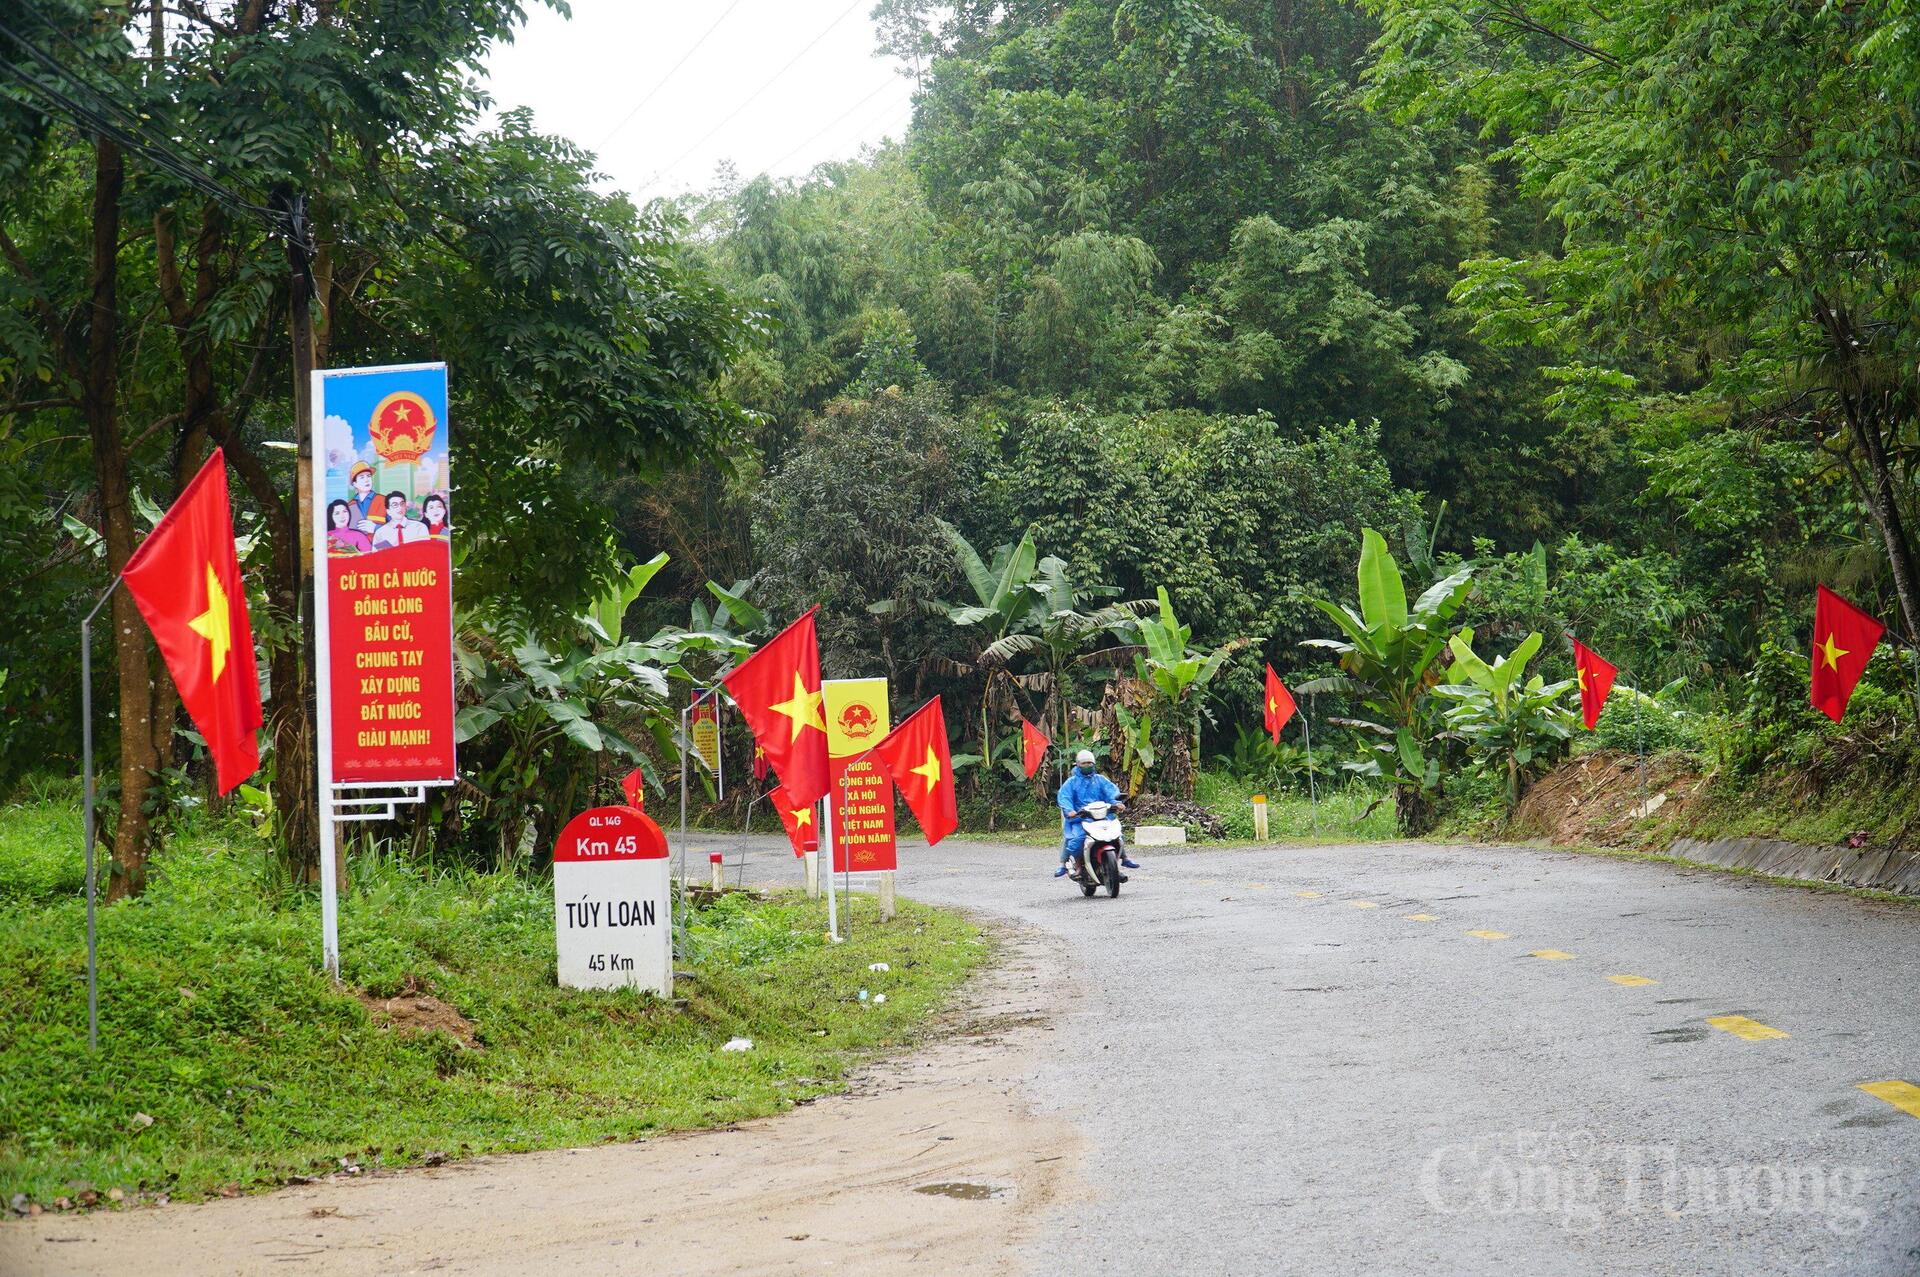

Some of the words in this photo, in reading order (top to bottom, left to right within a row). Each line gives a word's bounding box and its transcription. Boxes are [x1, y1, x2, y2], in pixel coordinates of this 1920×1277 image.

[340, 570, 358, 591] CỬ
[360, 574, 380, 589] TRI
[383, 568, 400, 588] CẢ
[402, 568, 437, 587] NƯỚC
[354, 595, 388, 615] ĐỒNG
[391, 595, 423, 614] LÒNG
[364, 620, 389, 642] BẦU
[392, 620, 414, 642] CỬ,
[356, 651, 398, 668] CHUNG
[401, 650, 424, 666] TAY
[361, 675, 384, 694] XÂY
[386, 675, 420, 696] DỰNG
[361, 699, 384, 720] ĐẤT
[387, 700, 421, 720] NƯỚC
[357, 727, 386, 747] GIÀU
[389, 729, 430, 749] MẠNH!
[848, 761, 872, 772] NƯỚC
[865, 774, 883, 785] HÒA
[847, 791, 859, 801] XÃ
[861, 790, 876, 801] HỘI
[839, 805, 857, 815] CHỦ
[859, 804, 886, 815] NGHĨA
[589, 817, 603, 827] QL
[605, 816, 621, 826] 14G
[842, 819, 861, 831] VIỆT
[863, 819, 884, 829] NAM
[576, 838, 609, 857] Km
[614, 836, 637, 854] 45
[839, 834, 866, 845] MUÔN
[868, 833, 891, 843] NĂM!
[565, 894, 601, 929] TÚY
[607, 900, 655, 928] LOAN
[588, 954, 606, 972] 45
[610, 953, 634, 971] Km
